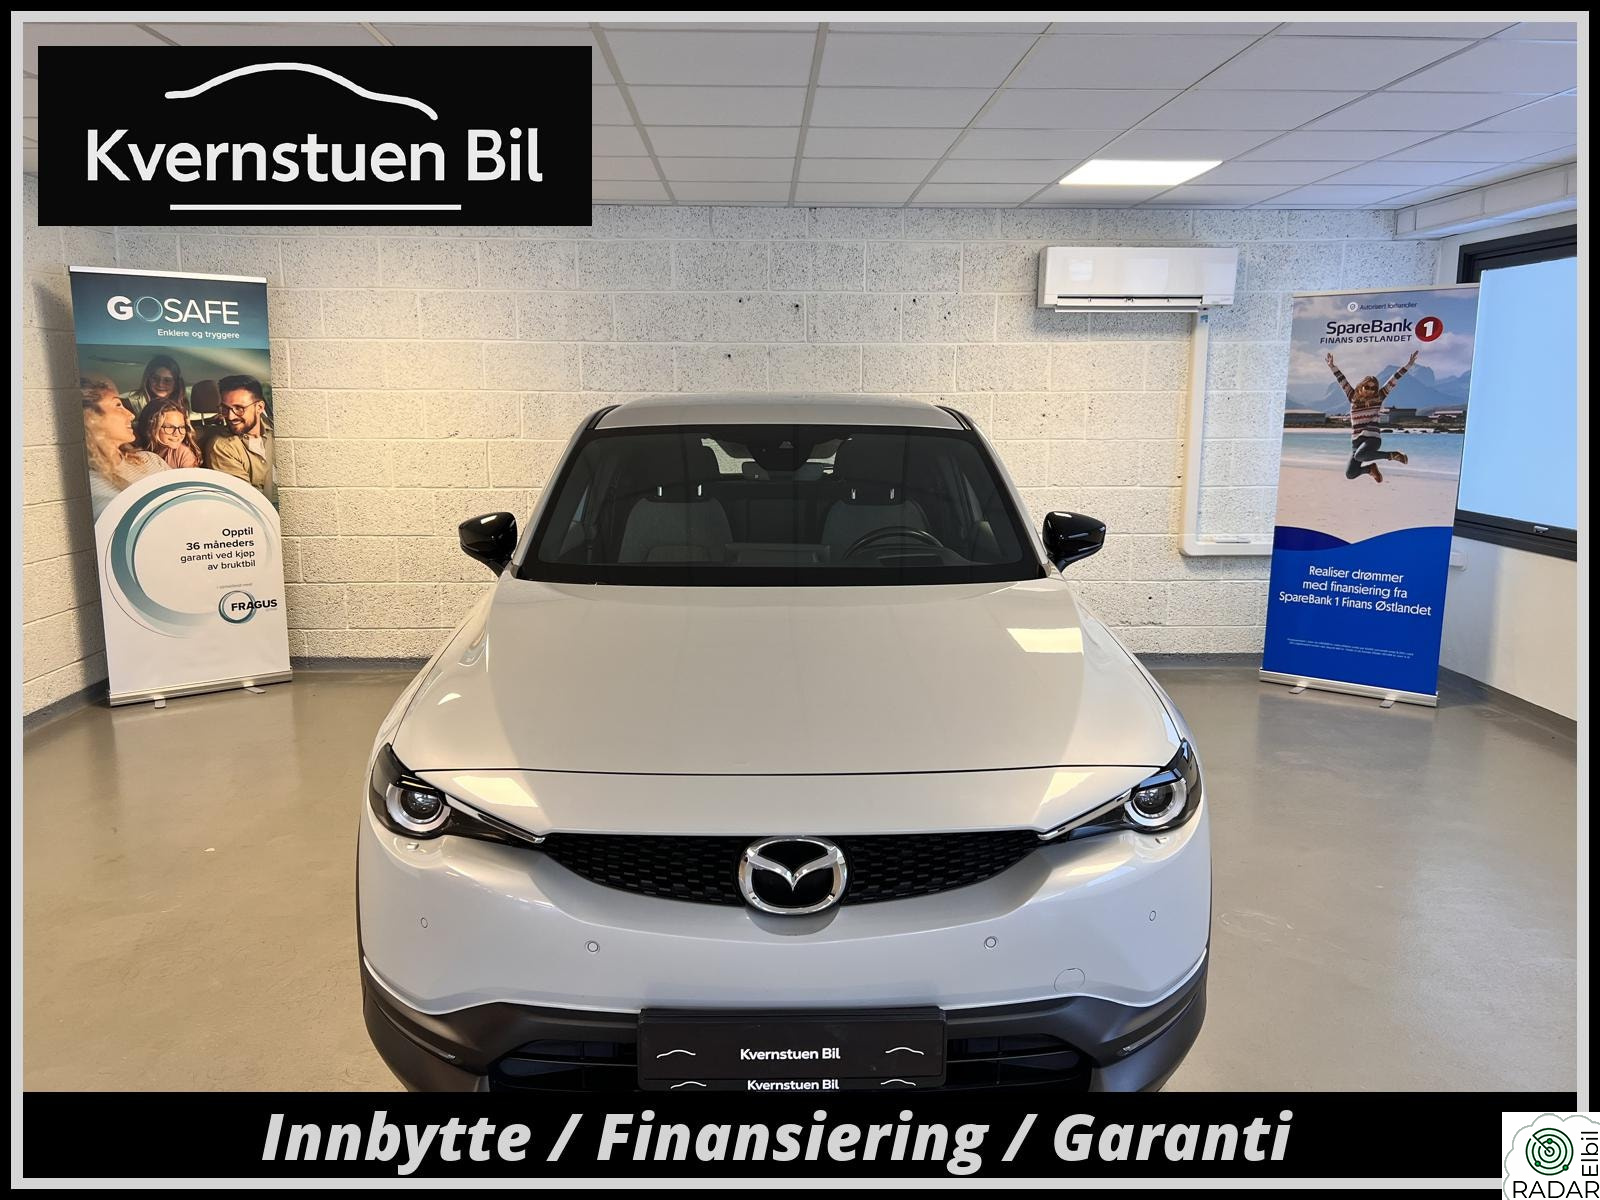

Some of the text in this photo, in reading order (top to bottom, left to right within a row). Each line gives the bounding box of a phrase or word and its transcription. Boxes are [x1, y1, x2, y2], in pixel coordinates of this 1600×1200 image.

[107, 295, 240, 325] GOSAFE
[157, 328, 240, 339] Enklere og tryggere
[1326, 318, 1434, 338] SpareBank 1
[1320, 334, 1413, 344] FINANS ØSTLANDET
[222, 526, 254, 538] Opptil
[186, 540, 255, 551] 36 måneders
[180, 549, 256, 564] garanti ved kjøp
[207, 559, 256, 571] av bruktbil
[1309, 565, 1404, 583] Realiser drømmer
[1302, 581, 1408, 599] med finansiering fra
[231, 599, 278, 611] FRAGUS
[1279, 591, 1432, 616] SpareBank 1 Finans Østlandet
[740, 1047, 841, 1060] Kvernstuen Bil
[747, 1078, 840, 1091] Kvernstuen Bil
